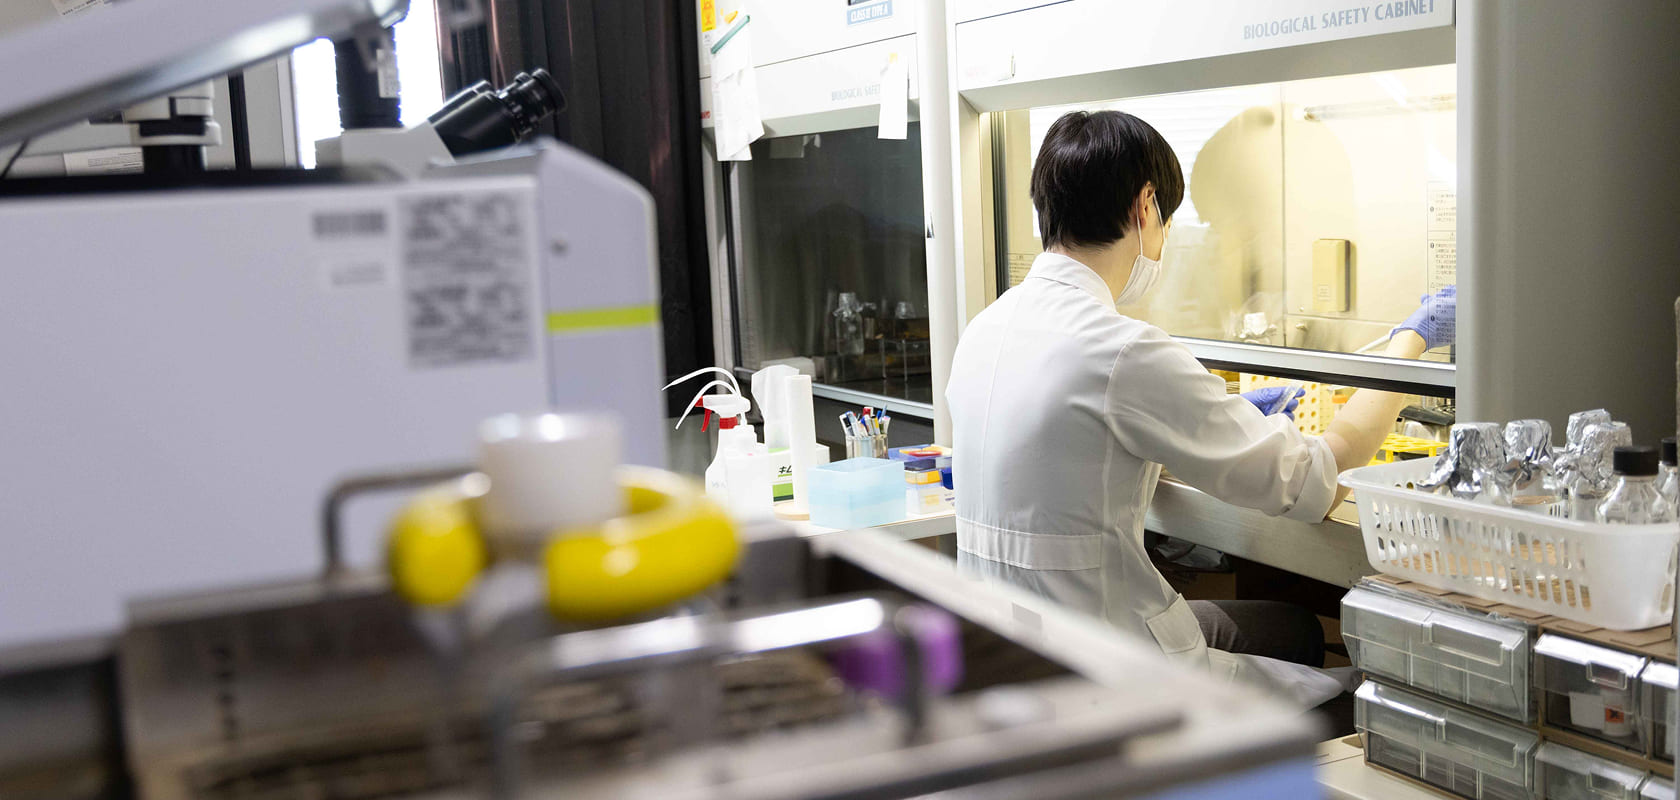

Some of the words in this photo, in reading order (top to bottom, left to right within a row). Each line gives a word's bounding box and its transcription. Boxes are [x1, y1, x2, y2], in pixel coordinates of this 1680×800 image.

[1243, 16, 1317, 40] BIOLOGICAL
[1322, 7, 1370, 29] SAFETY
[1374, 0, 1435, 21] CABINET
[864, 83, 880, 97] SAFET
[779, 465, 792, 474] キム
